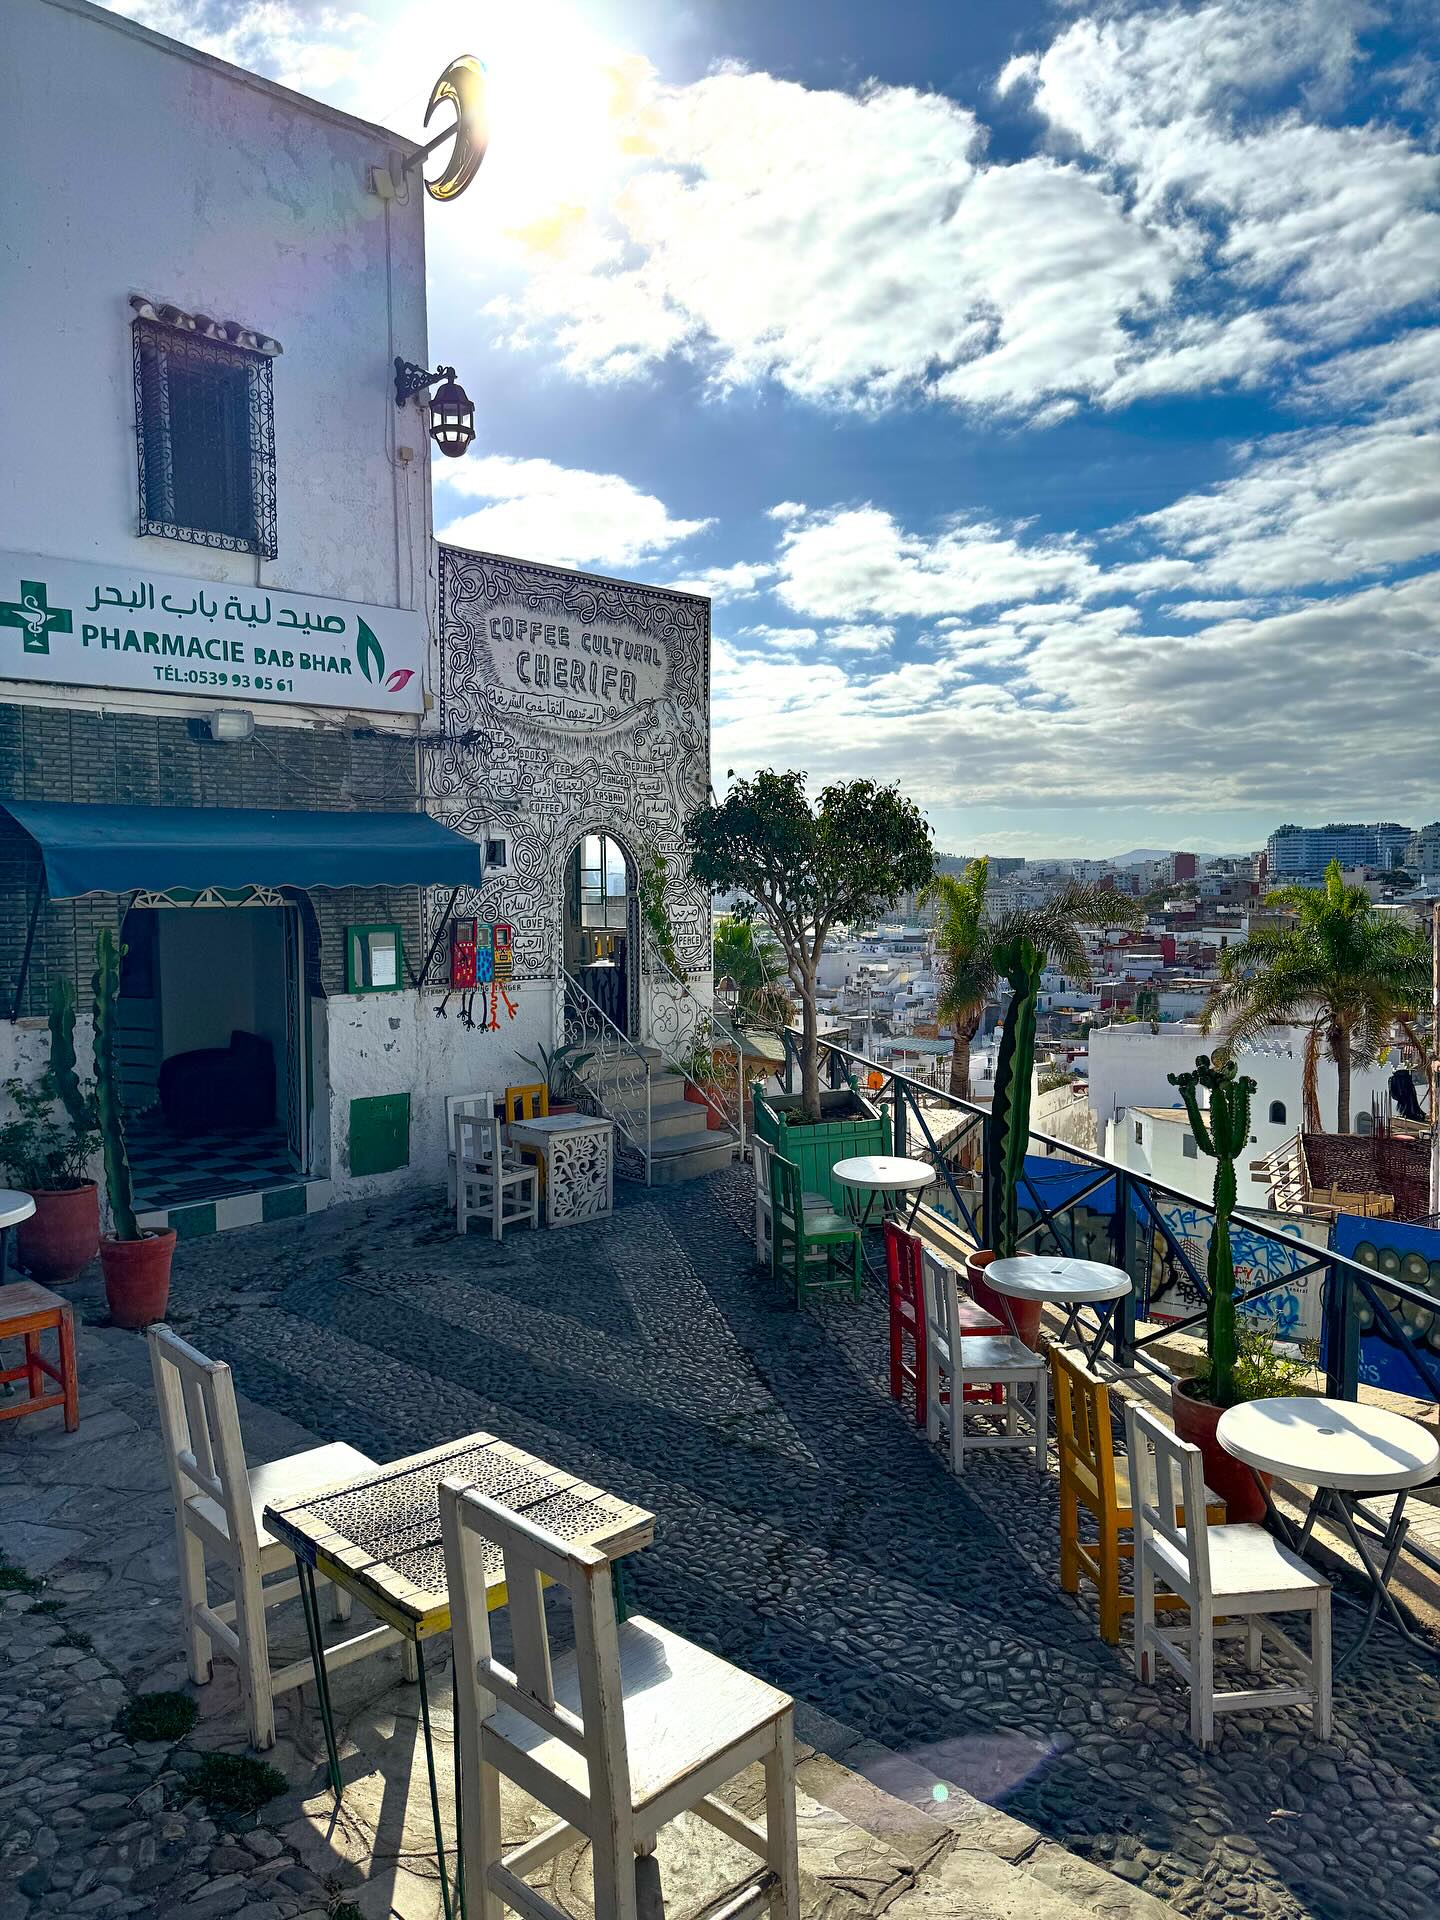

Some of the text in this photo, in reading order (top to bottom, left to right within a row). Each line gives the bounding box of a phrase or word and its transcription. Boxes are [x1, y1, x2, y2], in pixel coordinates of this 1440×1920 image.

[86, 582, 154, 614] البحر
[161, 590, 218, 623] باب
[489, 616, 570, 647] COFFEE
[82, 624, 352, 675] PHARMACIE BAB BHAR
[153, 665, 294, 692] TÉL:0539 93 05 61
[517, 651, 636, 702] CHERIFA
[519, 749, 547, 761] BOOKS
[556, 764, 571, 773] TEA
[625, 760, 653, 774] MEDINA
[603, 775, 629, 786] TANGER
[595, 791, 623, 802] KASBAH
[531, 803, 560, 813] COFFEE
[437, 890, 464, 902] GOS
[468, 877, 506, 913] ANYTHING
[521, 918, 542, 928] LOVE
[679, 936, 700, 946] PEACE
